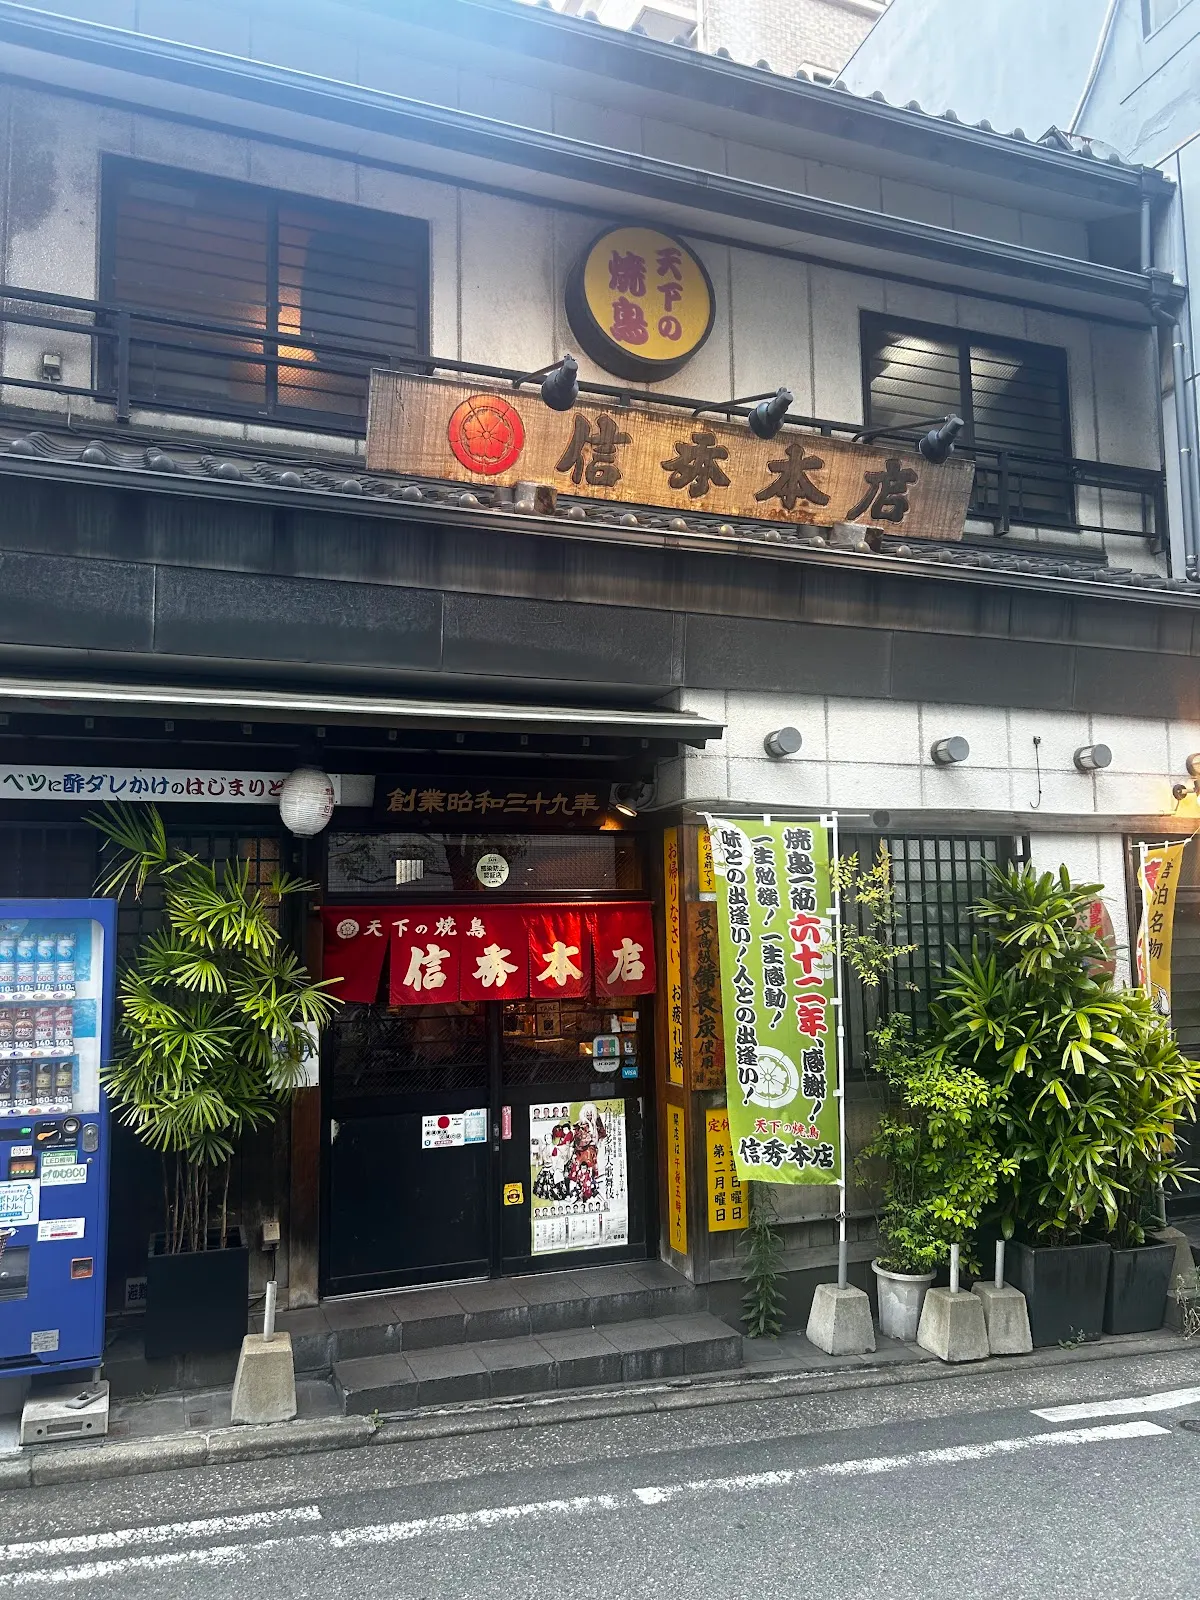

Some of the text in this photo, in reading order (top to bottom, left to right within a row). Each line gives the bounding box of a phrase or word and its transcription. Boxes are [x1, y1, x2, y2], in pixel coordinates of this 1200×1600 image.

[608, 249, 648, 346] 焼鳥
[654, 247, 684, 343] 天下の
[555, 411, 918, 525] 信秀本店
[386, 787, 601, 816] 創業昭和三十九年
[363, 916, 487, 938] 天下の焼鳥
[402, 937, 646, 992] 信秀本店
[598, 1046, 615, 1054] JCB
[754, 1118, 820, 1140] 天下の焼鳥
[738, 1137, 835, 1169] 信秀本店
[713, 1144, 727, 1222] 第二月曜日
